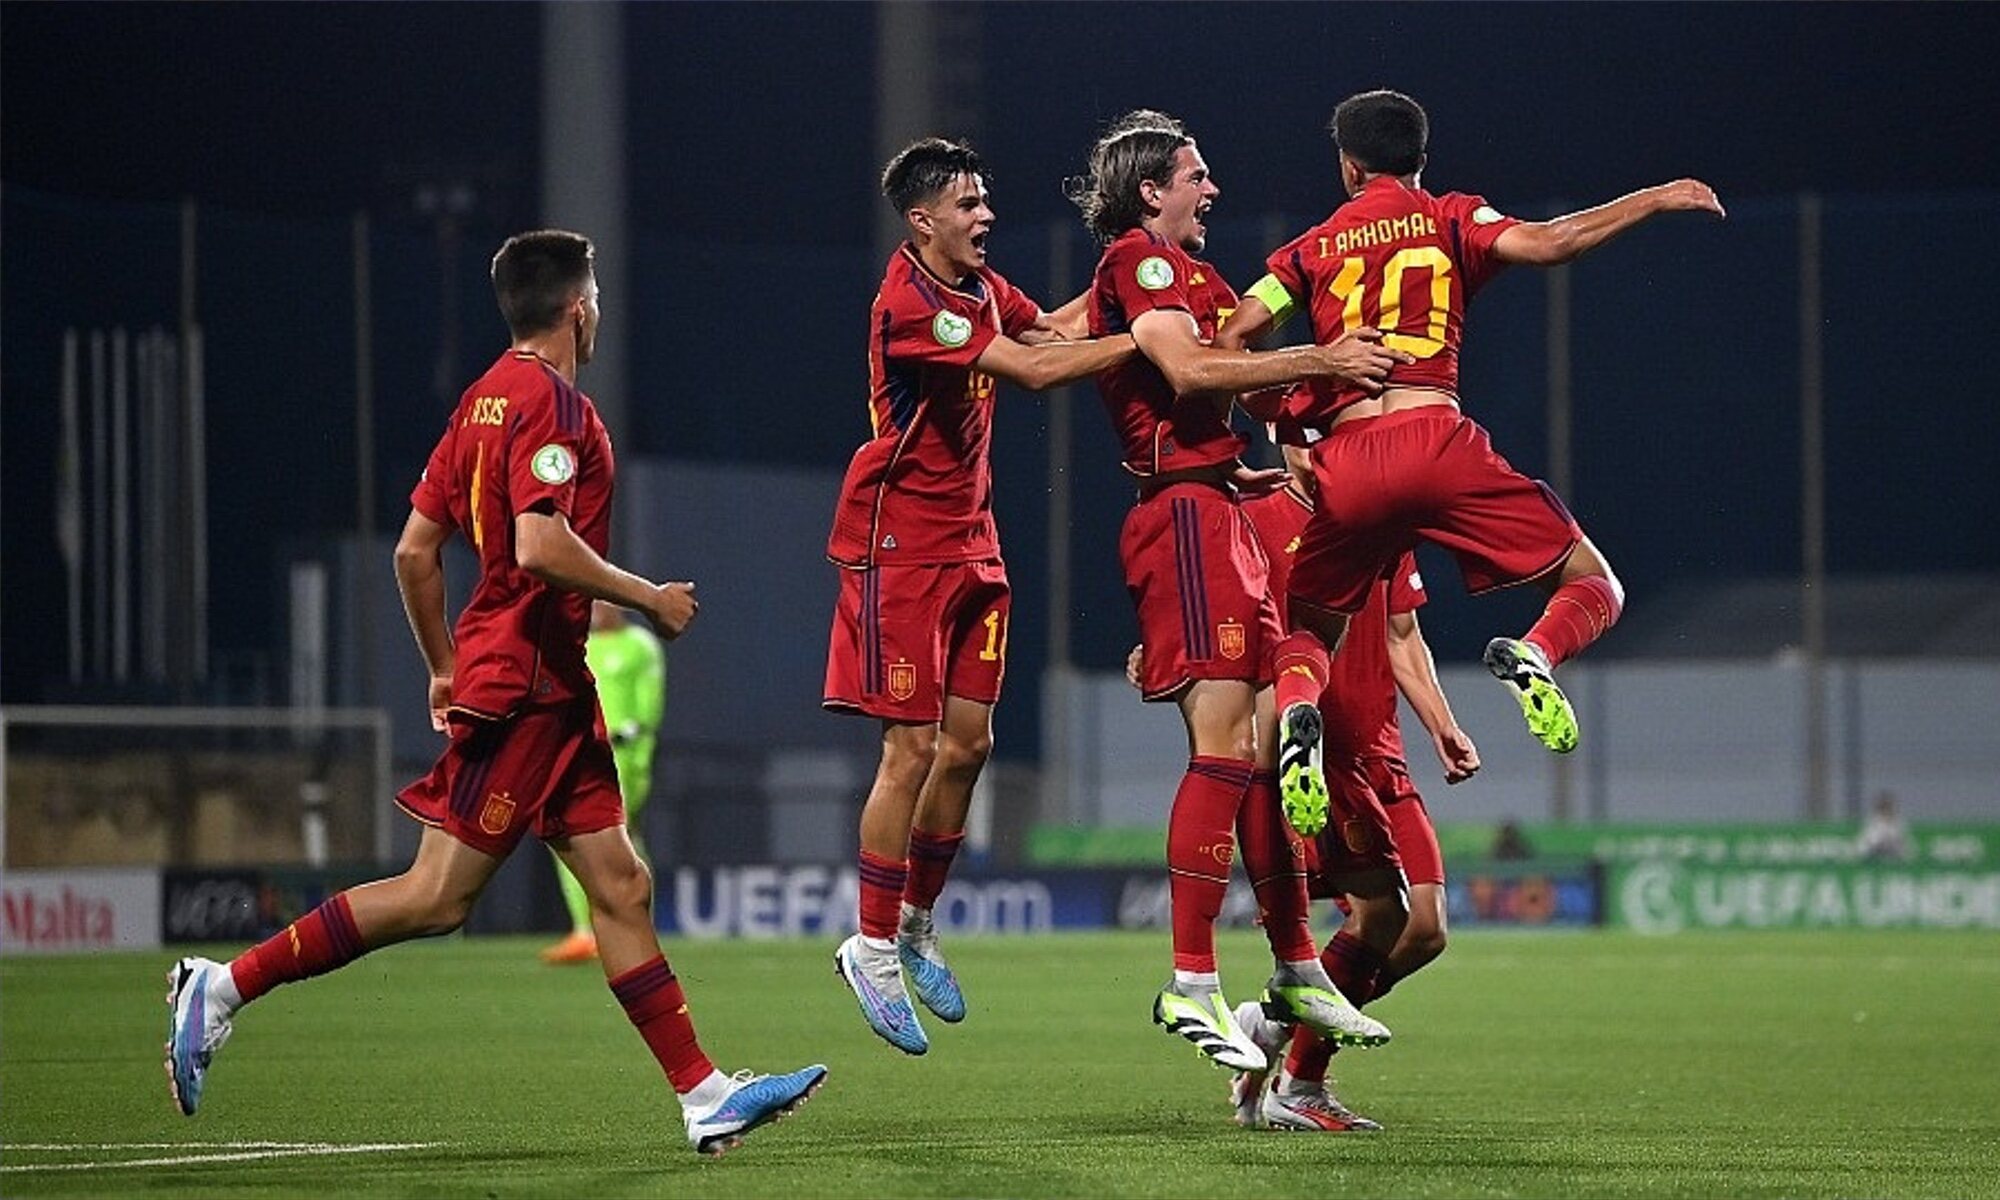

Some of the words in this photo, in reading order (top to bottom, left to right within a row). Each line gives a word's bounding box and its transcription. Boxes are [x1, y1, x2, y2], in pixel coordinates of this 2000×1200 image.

[1330, 247, 1451, 358] 10
[0, 885, 115, 943] Malta
[674, 866, 1053, 935] UEFAom
